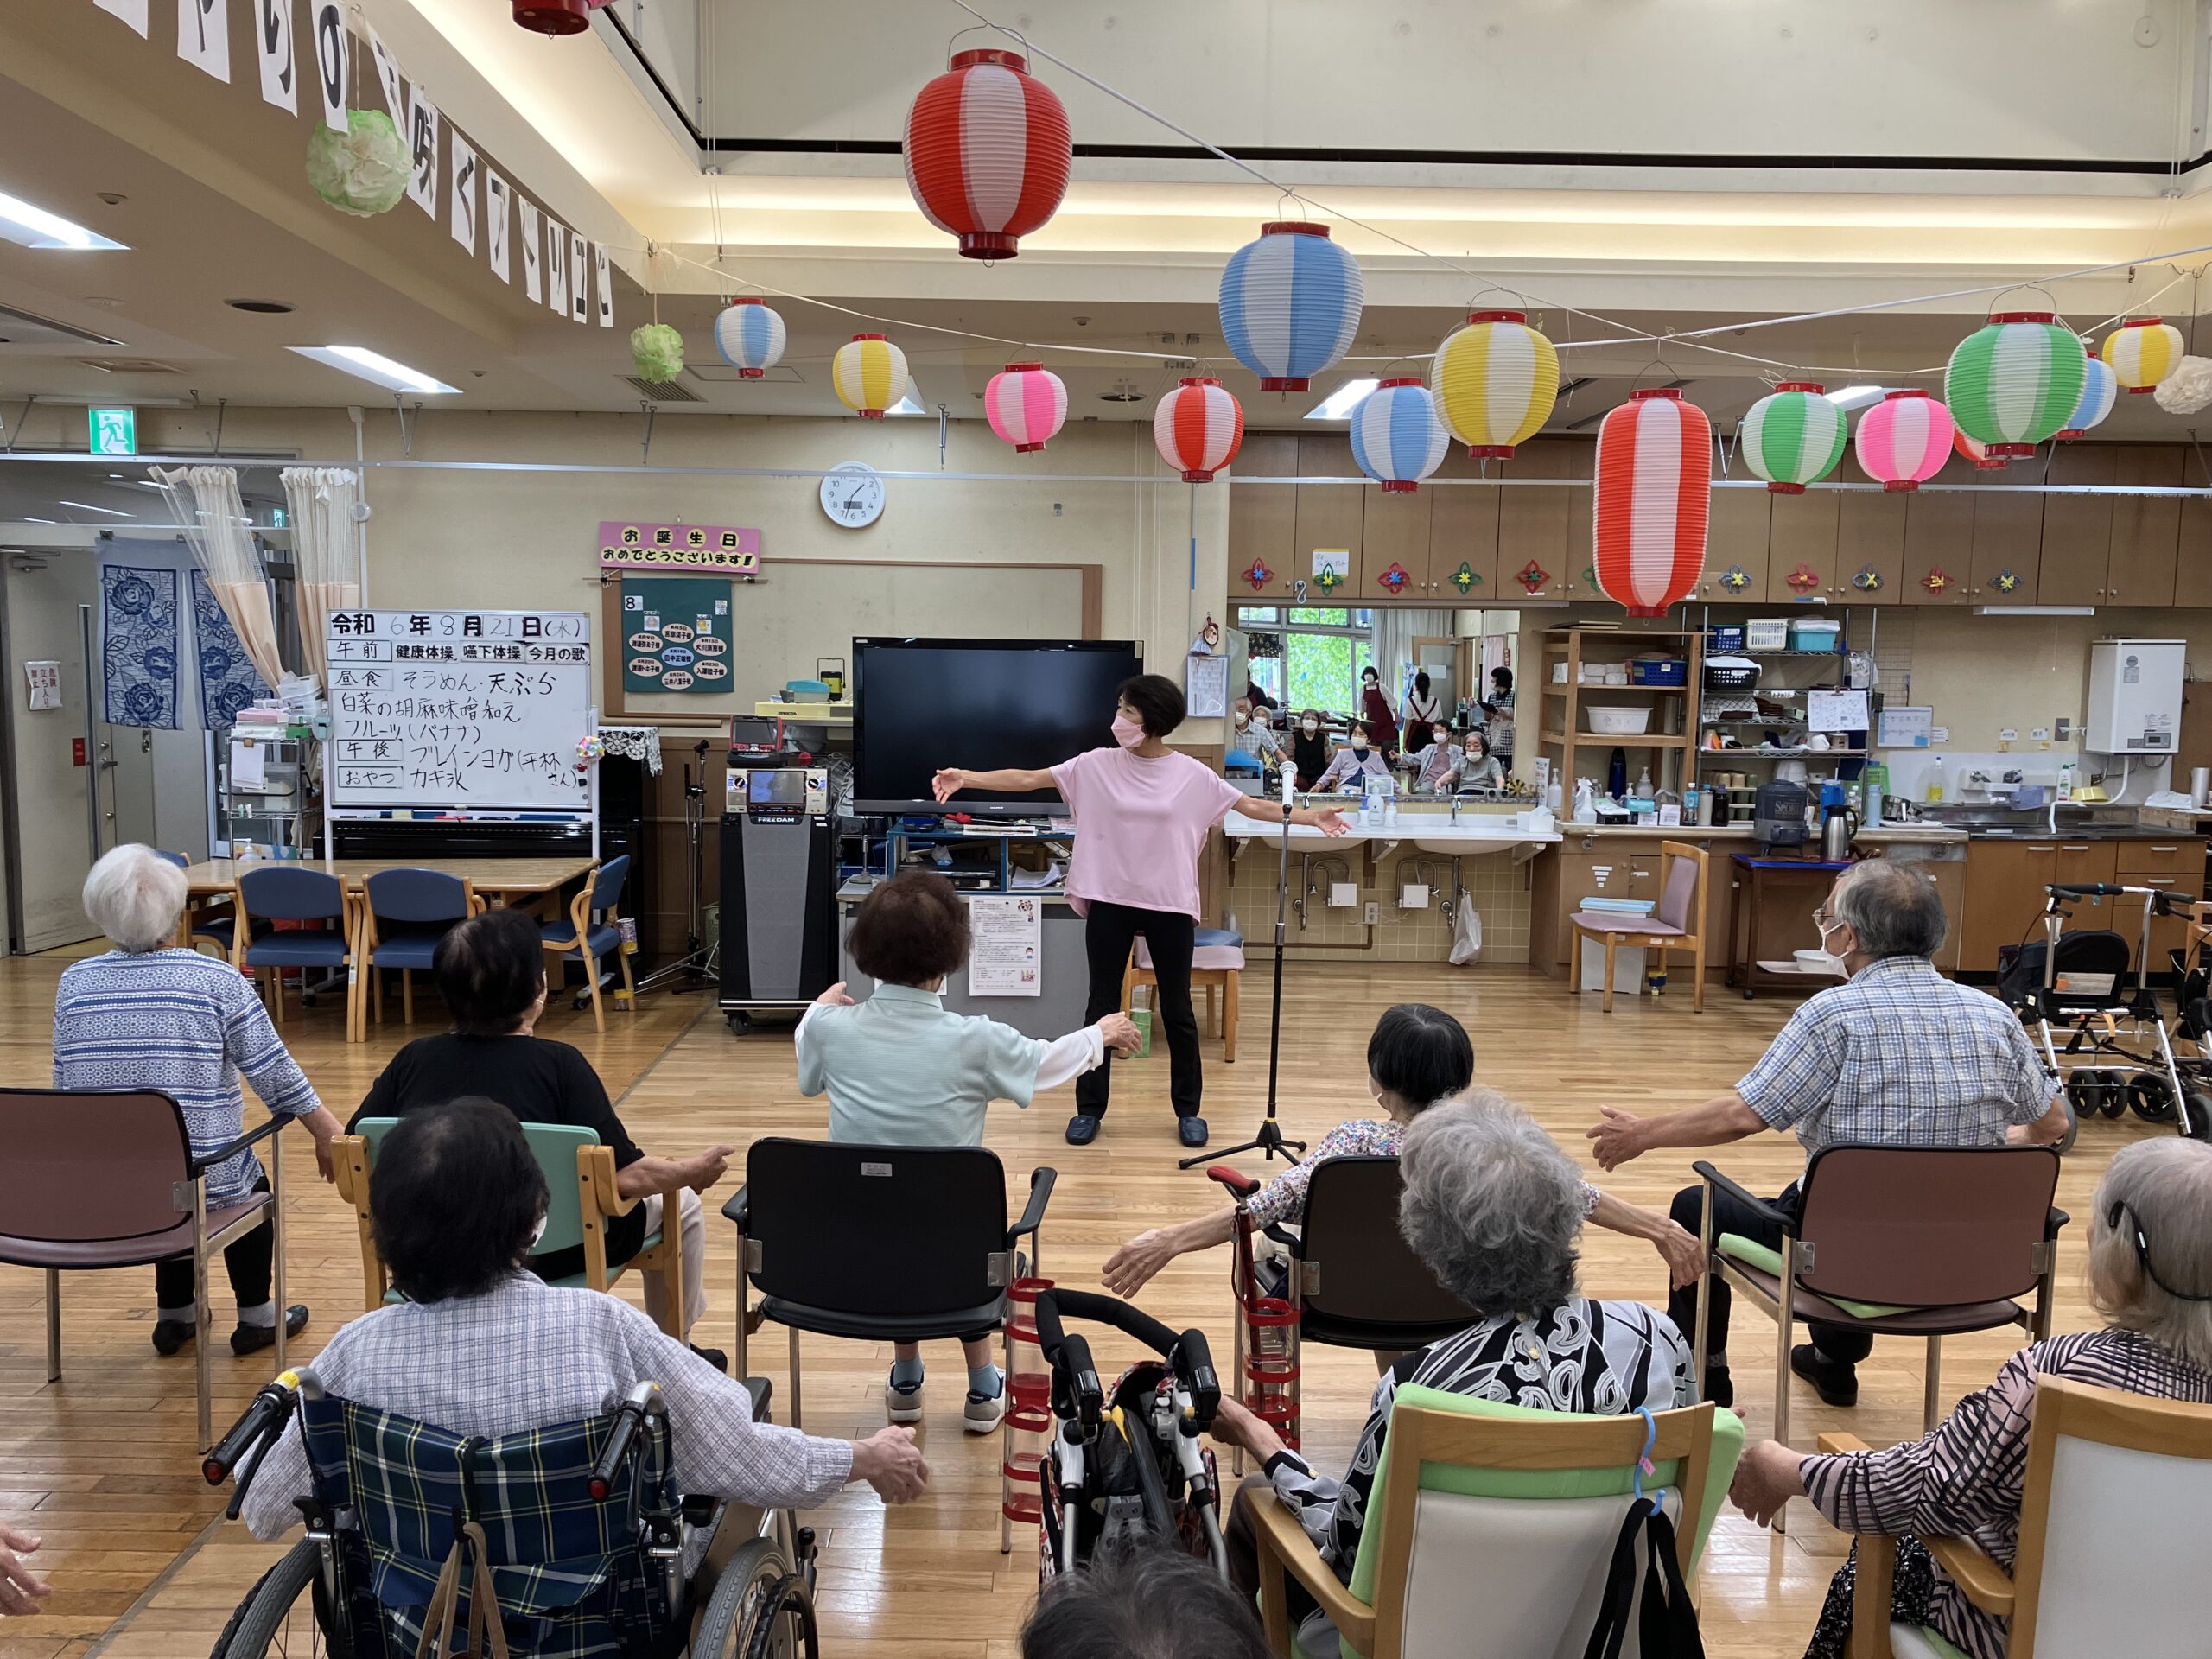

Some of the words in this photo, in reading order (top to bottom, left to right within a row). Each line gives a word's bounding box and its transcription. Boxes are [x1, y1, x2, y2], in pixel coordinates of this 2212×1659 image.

[624, 525, 736, 547] お誕生日
[626, 597, 635, 609] 8
[336, 641, 378, 660] 午前
[396, 645, 454, 660] 健康体操
[464, 645, 522, 660] 嚥下体操
[529, 647, 586, 662] 今月の歌
[48, 668, 57, 688] 危険
[335, 671, 383, 688] 昼食
[40, 669, 49, 708] 立ち入り
[346, 741, 391, 760] 午後
[346, 771, 394, 786] おやつ
[410, 767, 470, 791] カキ氷
